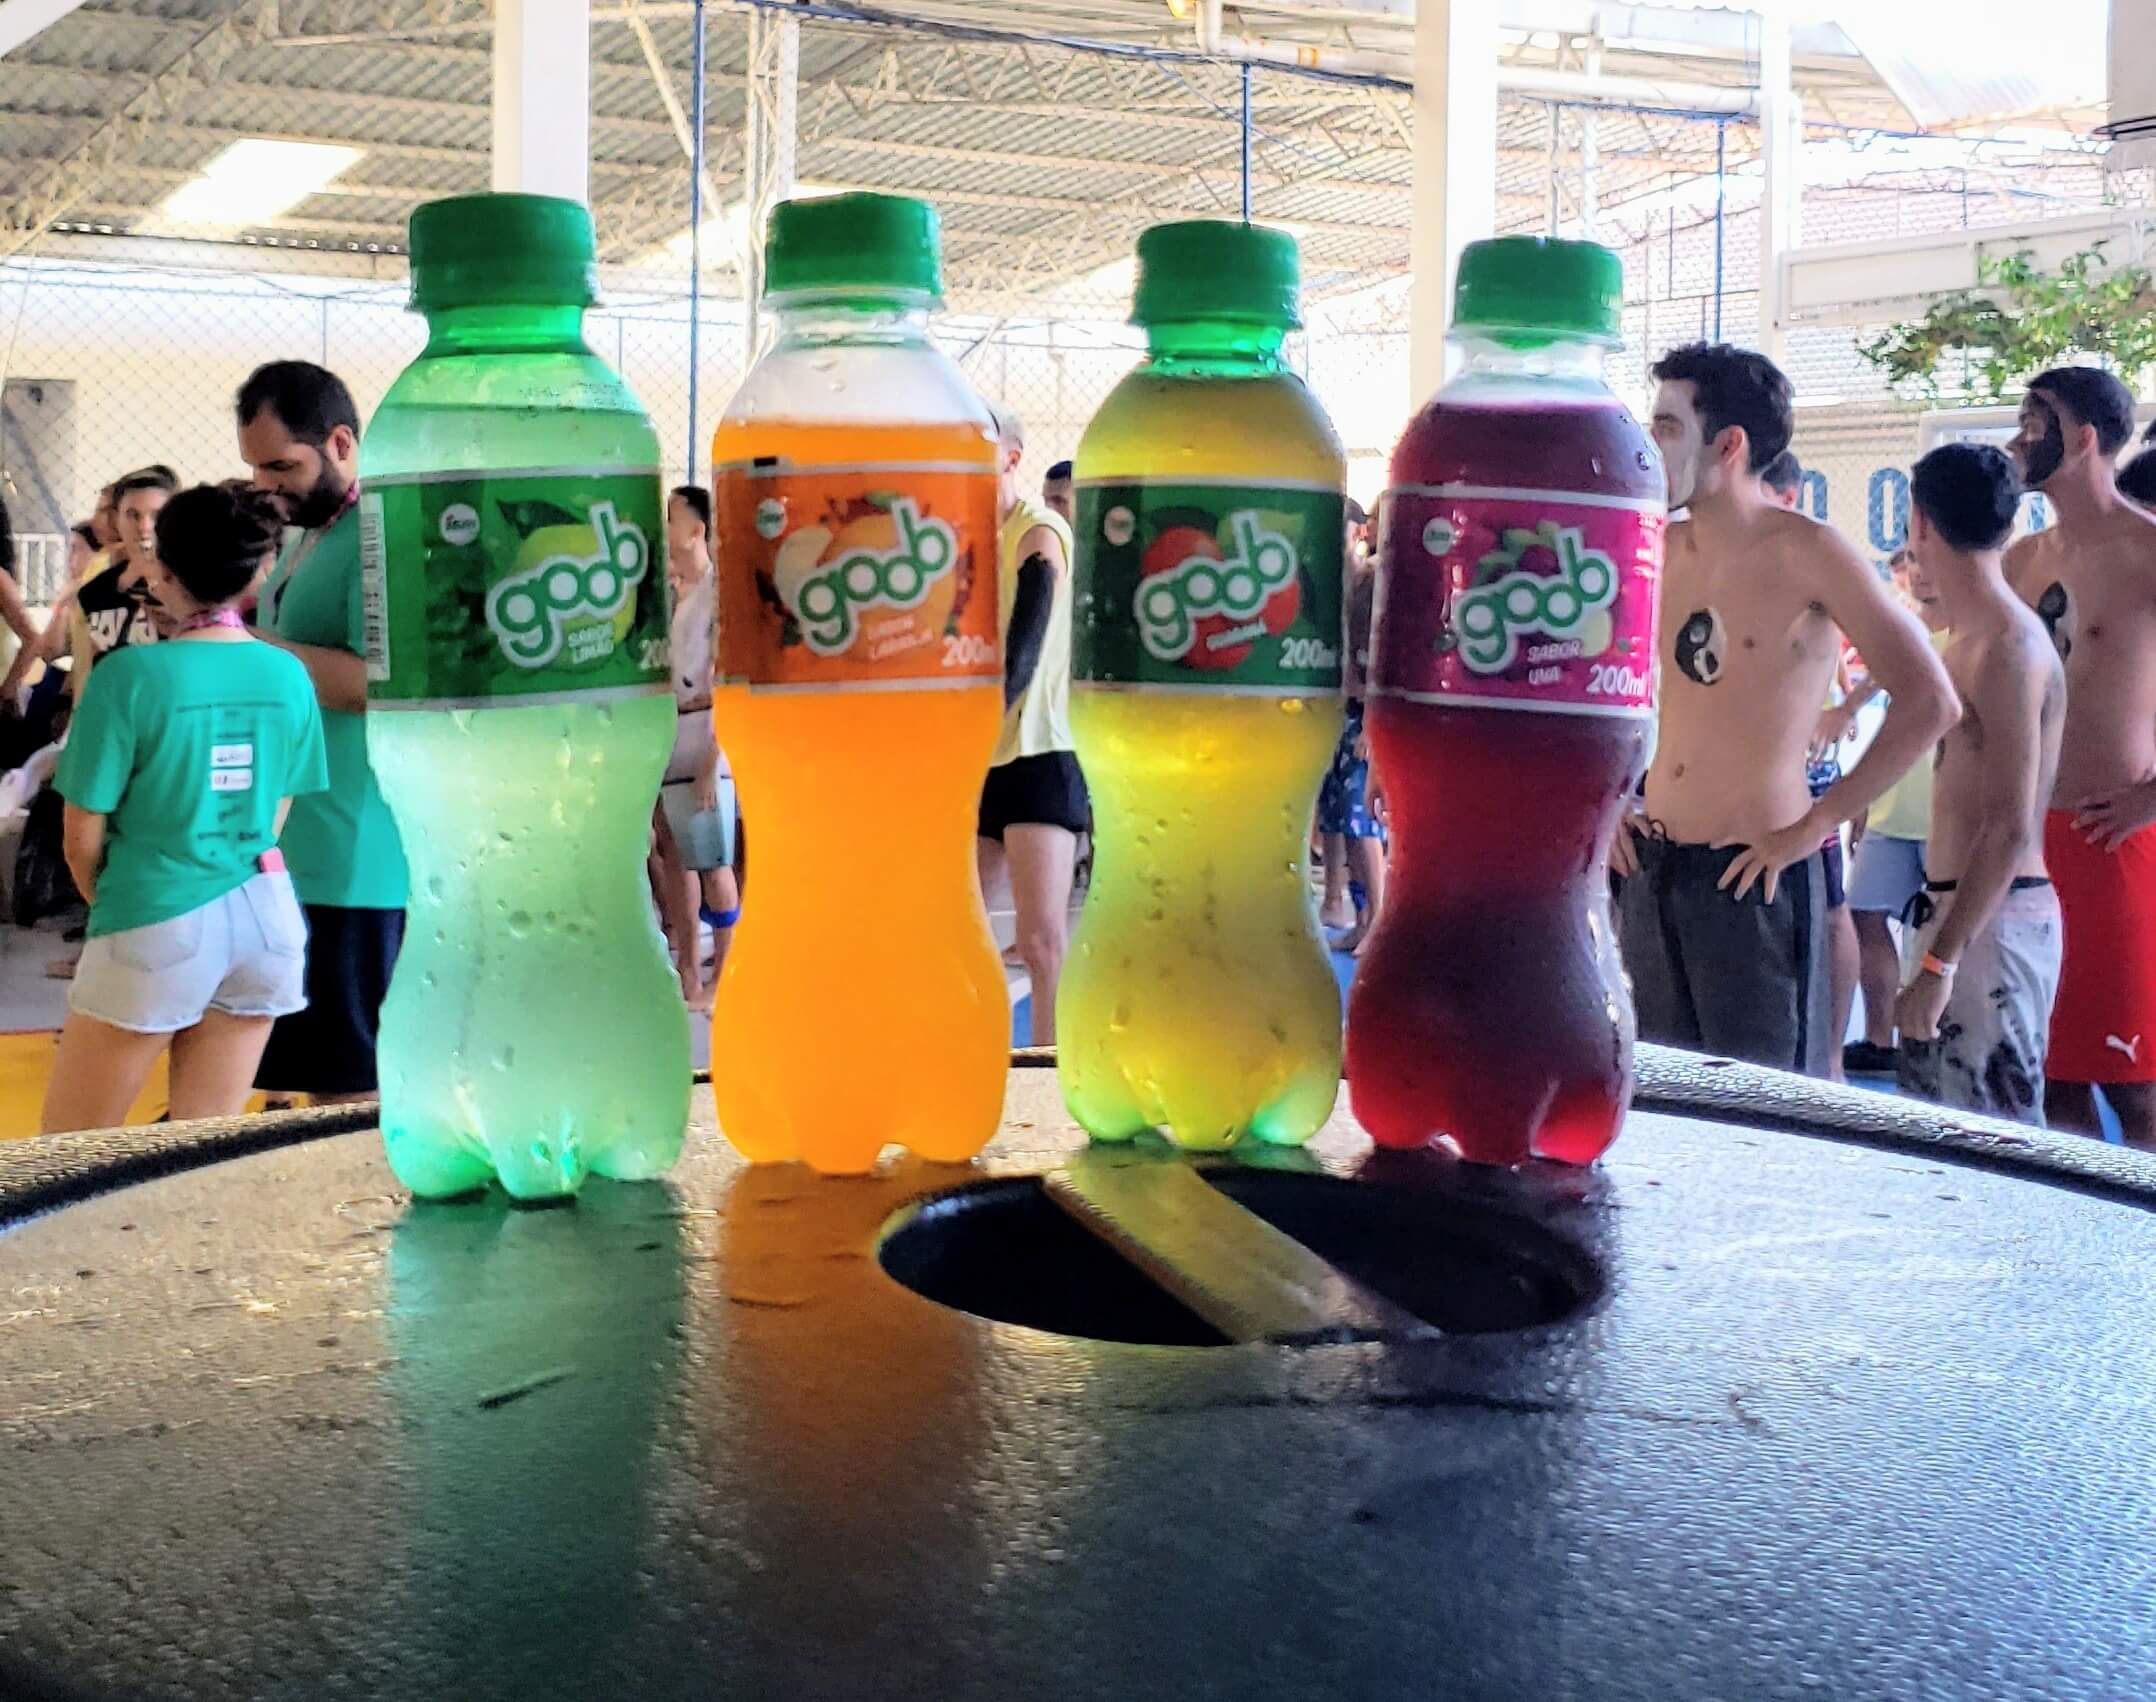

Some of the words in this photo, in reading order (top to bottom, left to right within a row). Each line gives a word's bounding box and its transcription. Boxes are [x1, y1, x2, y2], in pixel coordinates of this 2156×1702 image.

[493, 507, 646, 661] goob
[796, 503, 951, 650] goob
[1140, 516, 1292, 651] goob
[1459, 534, 1613, 666] goob
[1527, 640, 1580, 662] SABOR
[1528, 665, 1562, 686] UVA
[1585, 663, 1649, 697] 200ml
